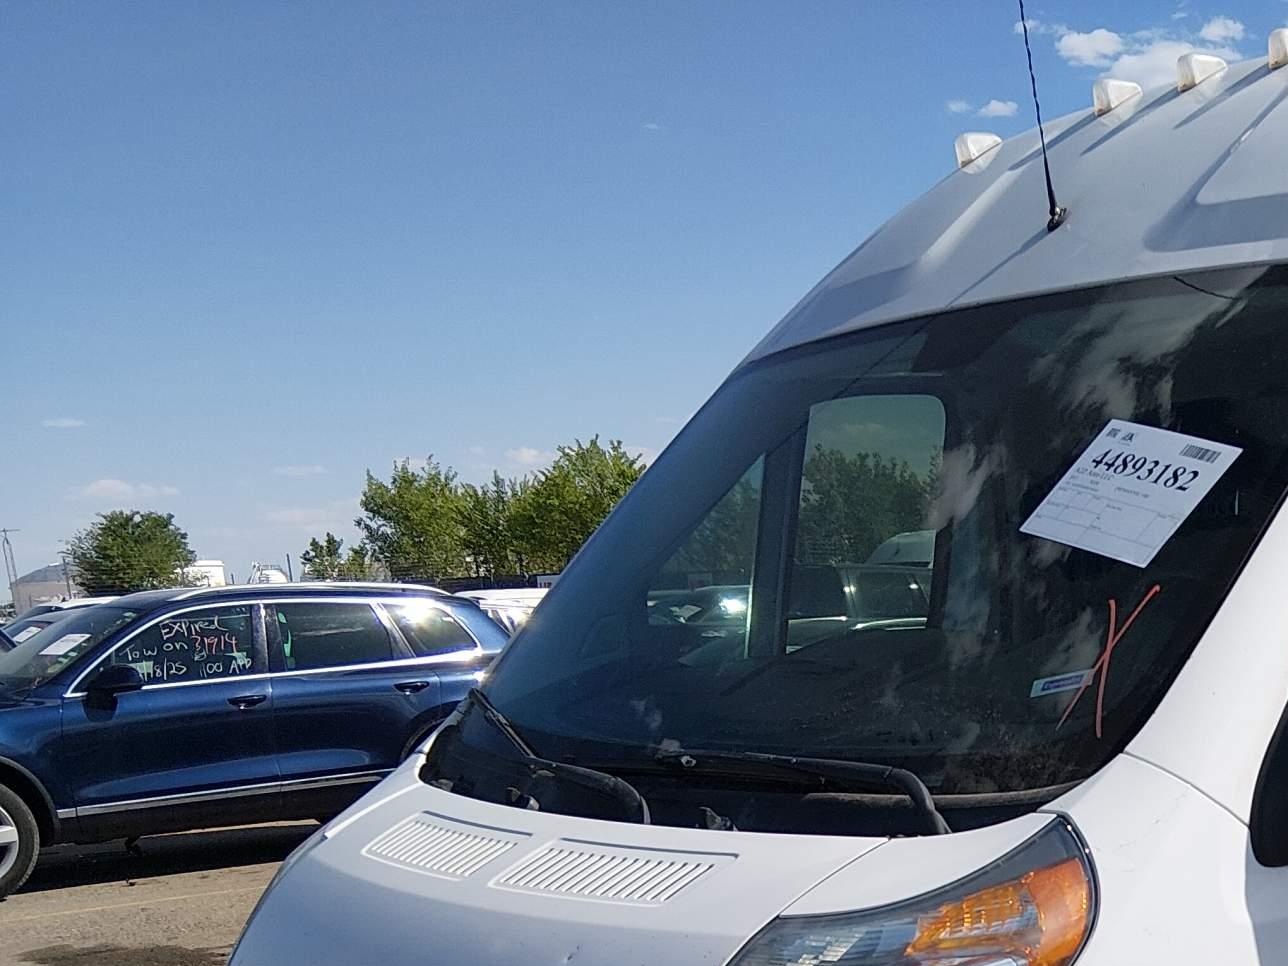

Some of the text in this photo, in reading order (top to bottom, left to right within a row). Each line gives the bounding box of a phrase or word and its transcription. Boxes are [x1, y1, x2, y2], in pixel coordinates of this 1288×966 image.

[1092, 448, 1200, 492] 44893182
[119, 640, 189, 661] Tow on
